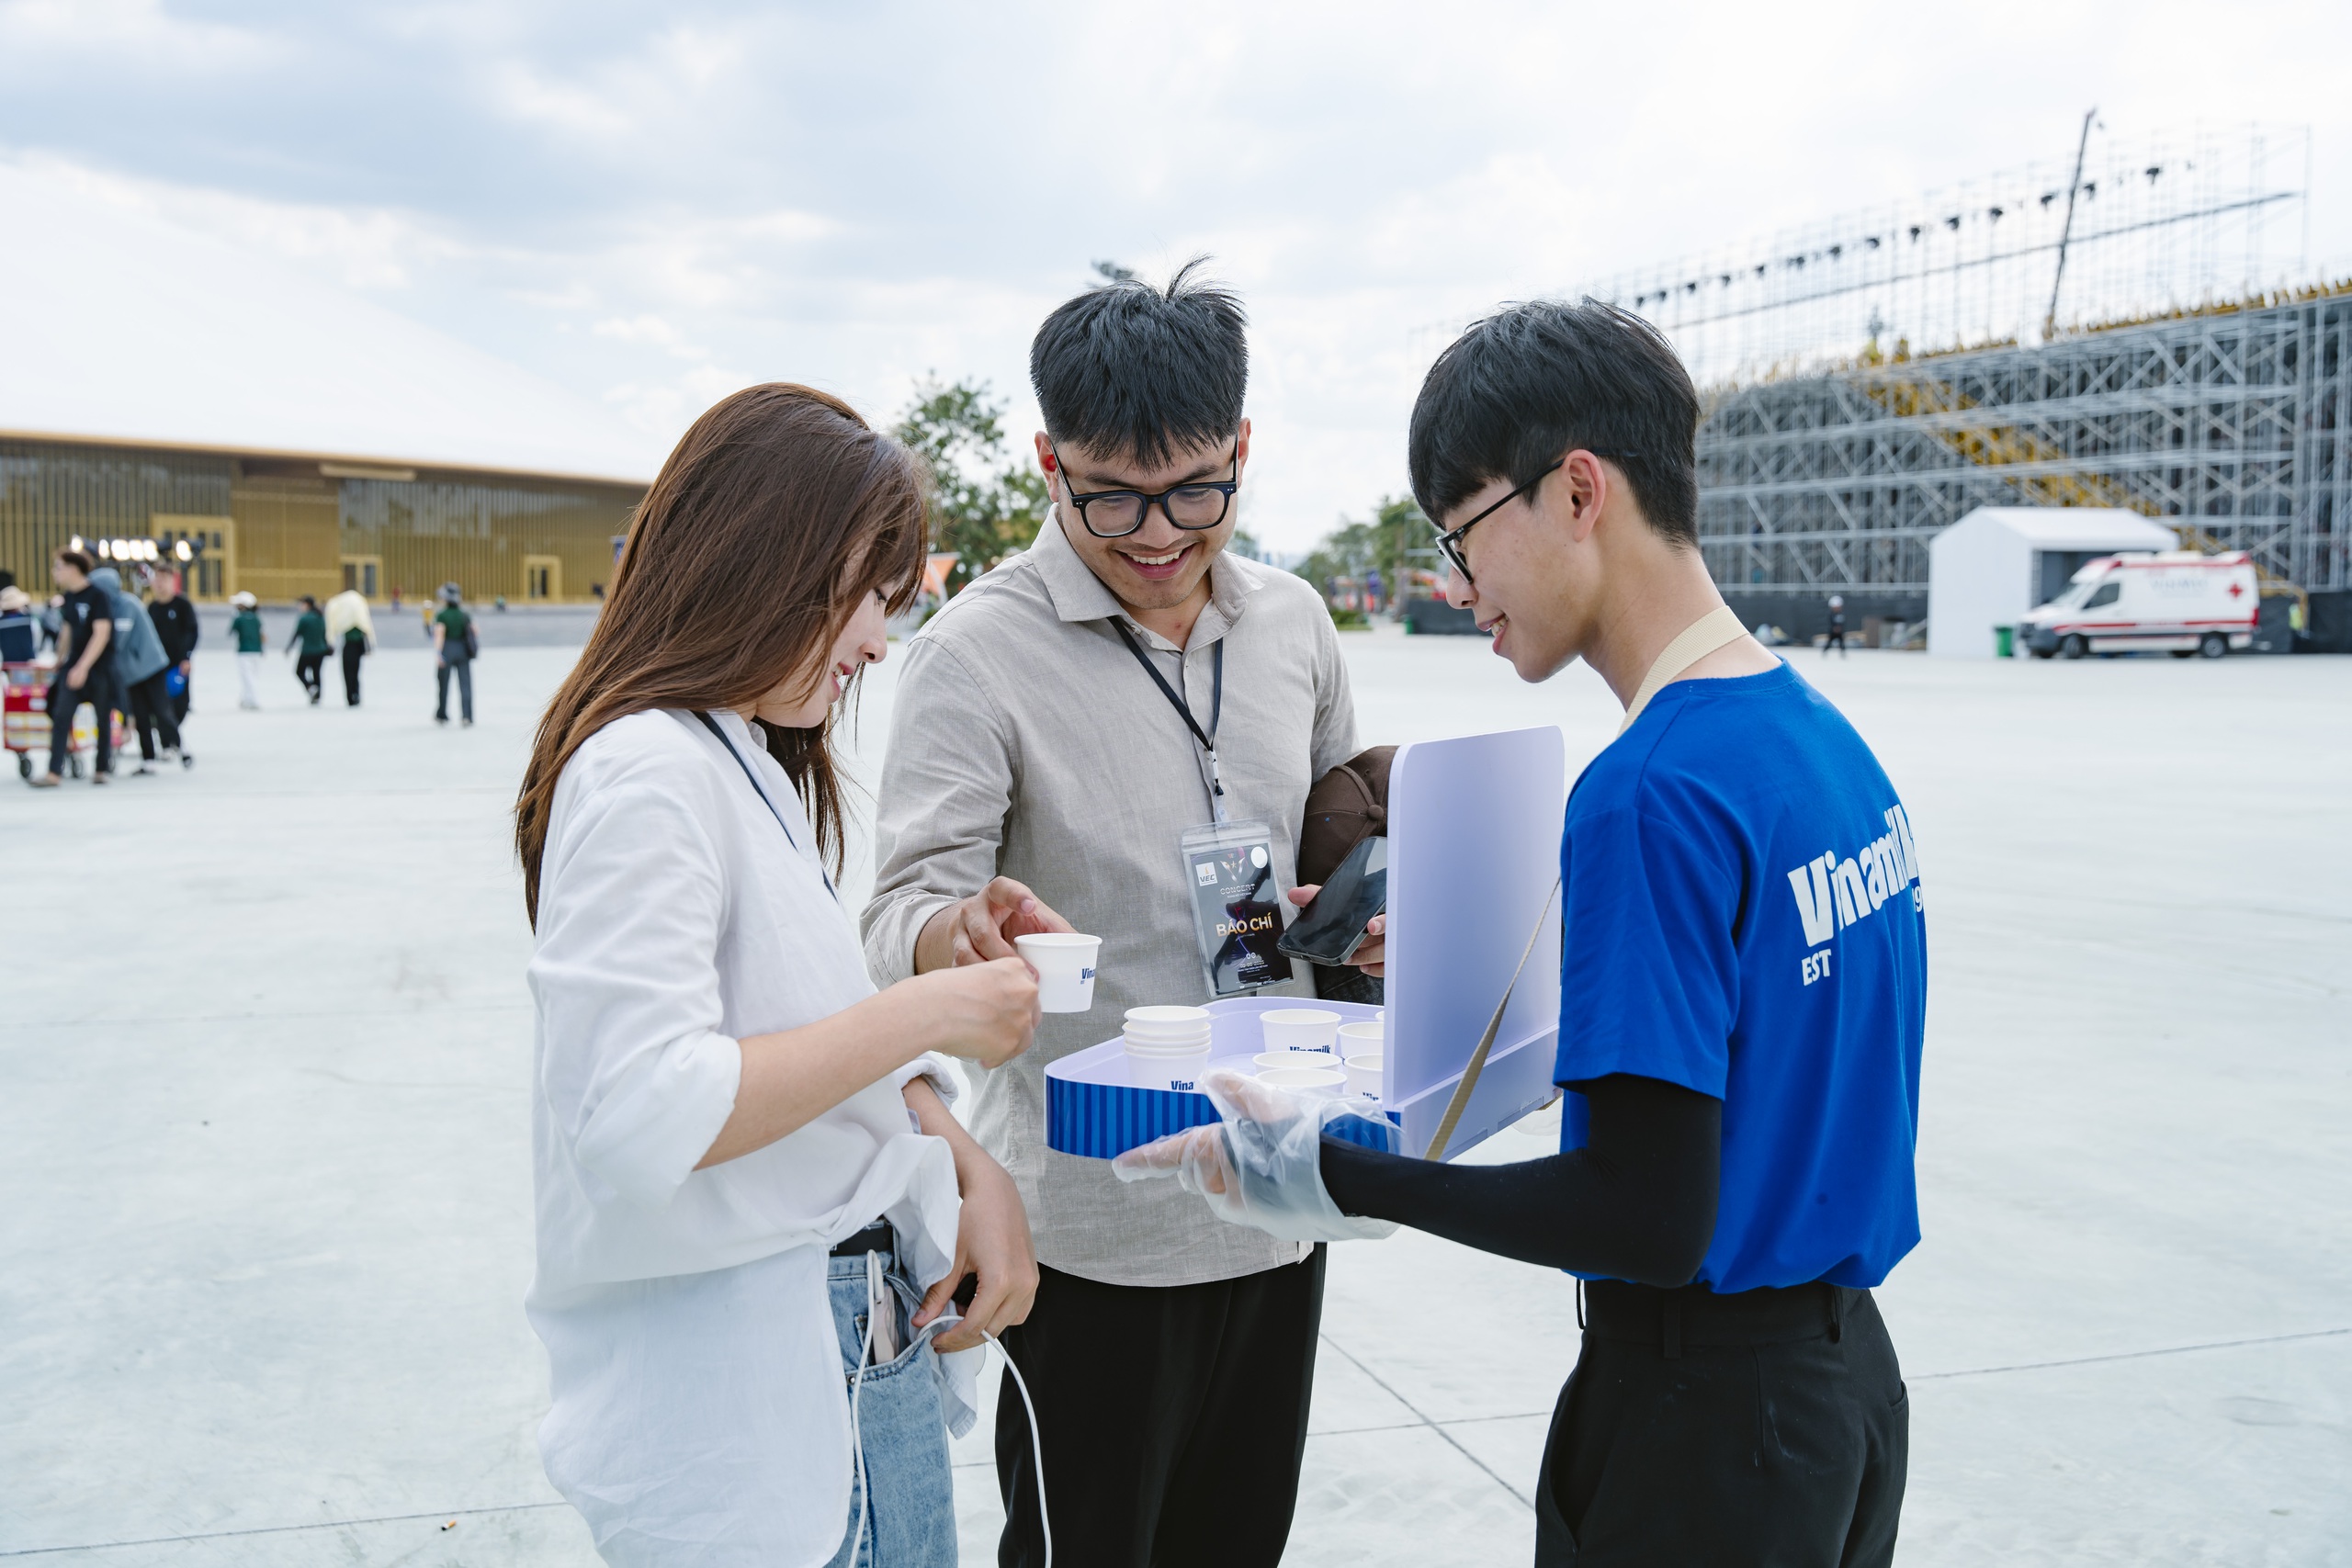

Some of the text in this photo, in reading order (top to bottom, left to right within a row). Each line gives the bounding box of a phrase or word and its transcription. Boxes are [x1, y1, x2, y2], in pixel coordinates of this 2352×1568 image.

[1200, 874, 1216, 883] VEC
[1220, 884, 1256, 895] CONCERT
[1216, 919, 1248, 937] BÁO
[1250, 912, 1273, 931] CHÍ
[1802, 949, 1832, 986] EST
